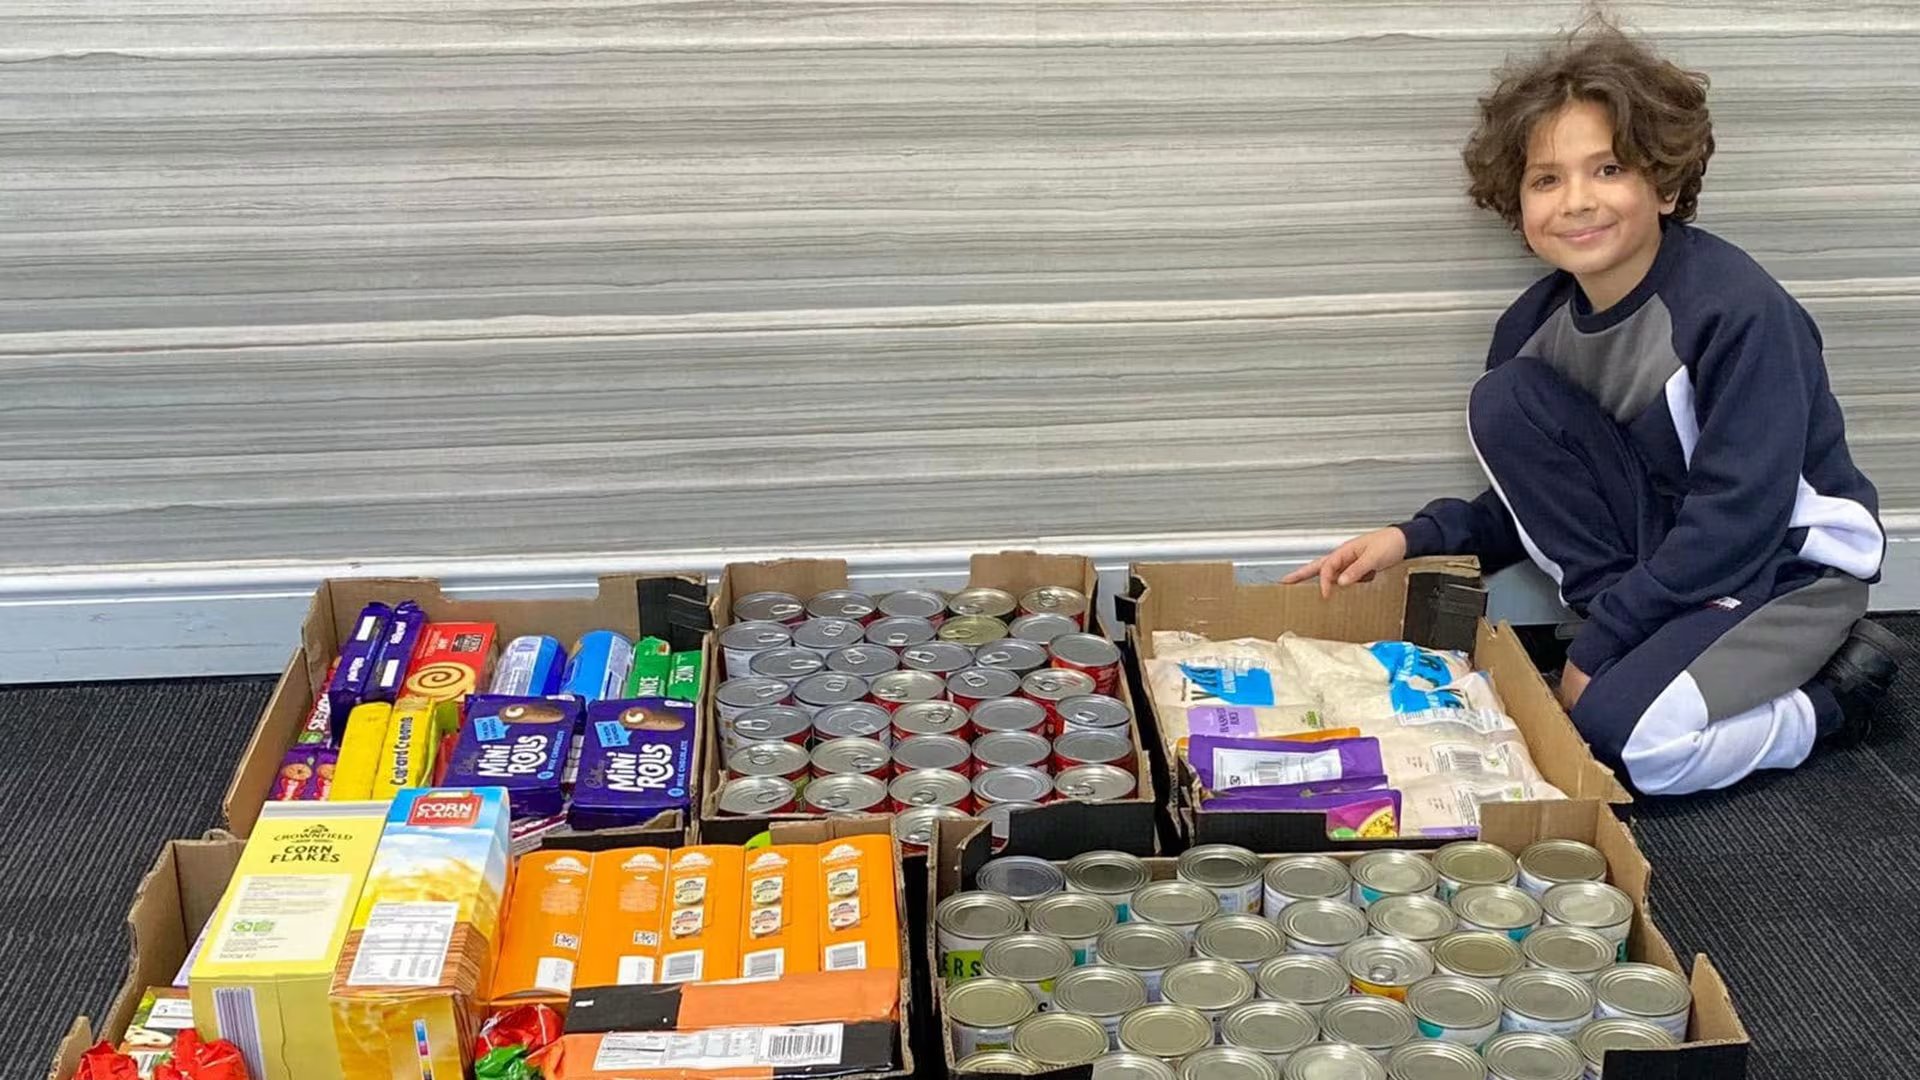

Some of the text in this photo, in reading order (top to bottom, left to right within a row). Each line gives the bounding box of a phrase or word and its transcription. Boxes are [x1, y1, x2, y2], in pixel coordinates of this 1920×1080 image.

[507, 735, 548, 774] ROLLS
[637, 744, 675, 788] ROLLS
[418, 802, 473, 812] CORN
[273, 832, 354, 842] CROWNFIELD
[284, 845, 334, 854] CORN
[270, 853, 342, 864] FLAKES
